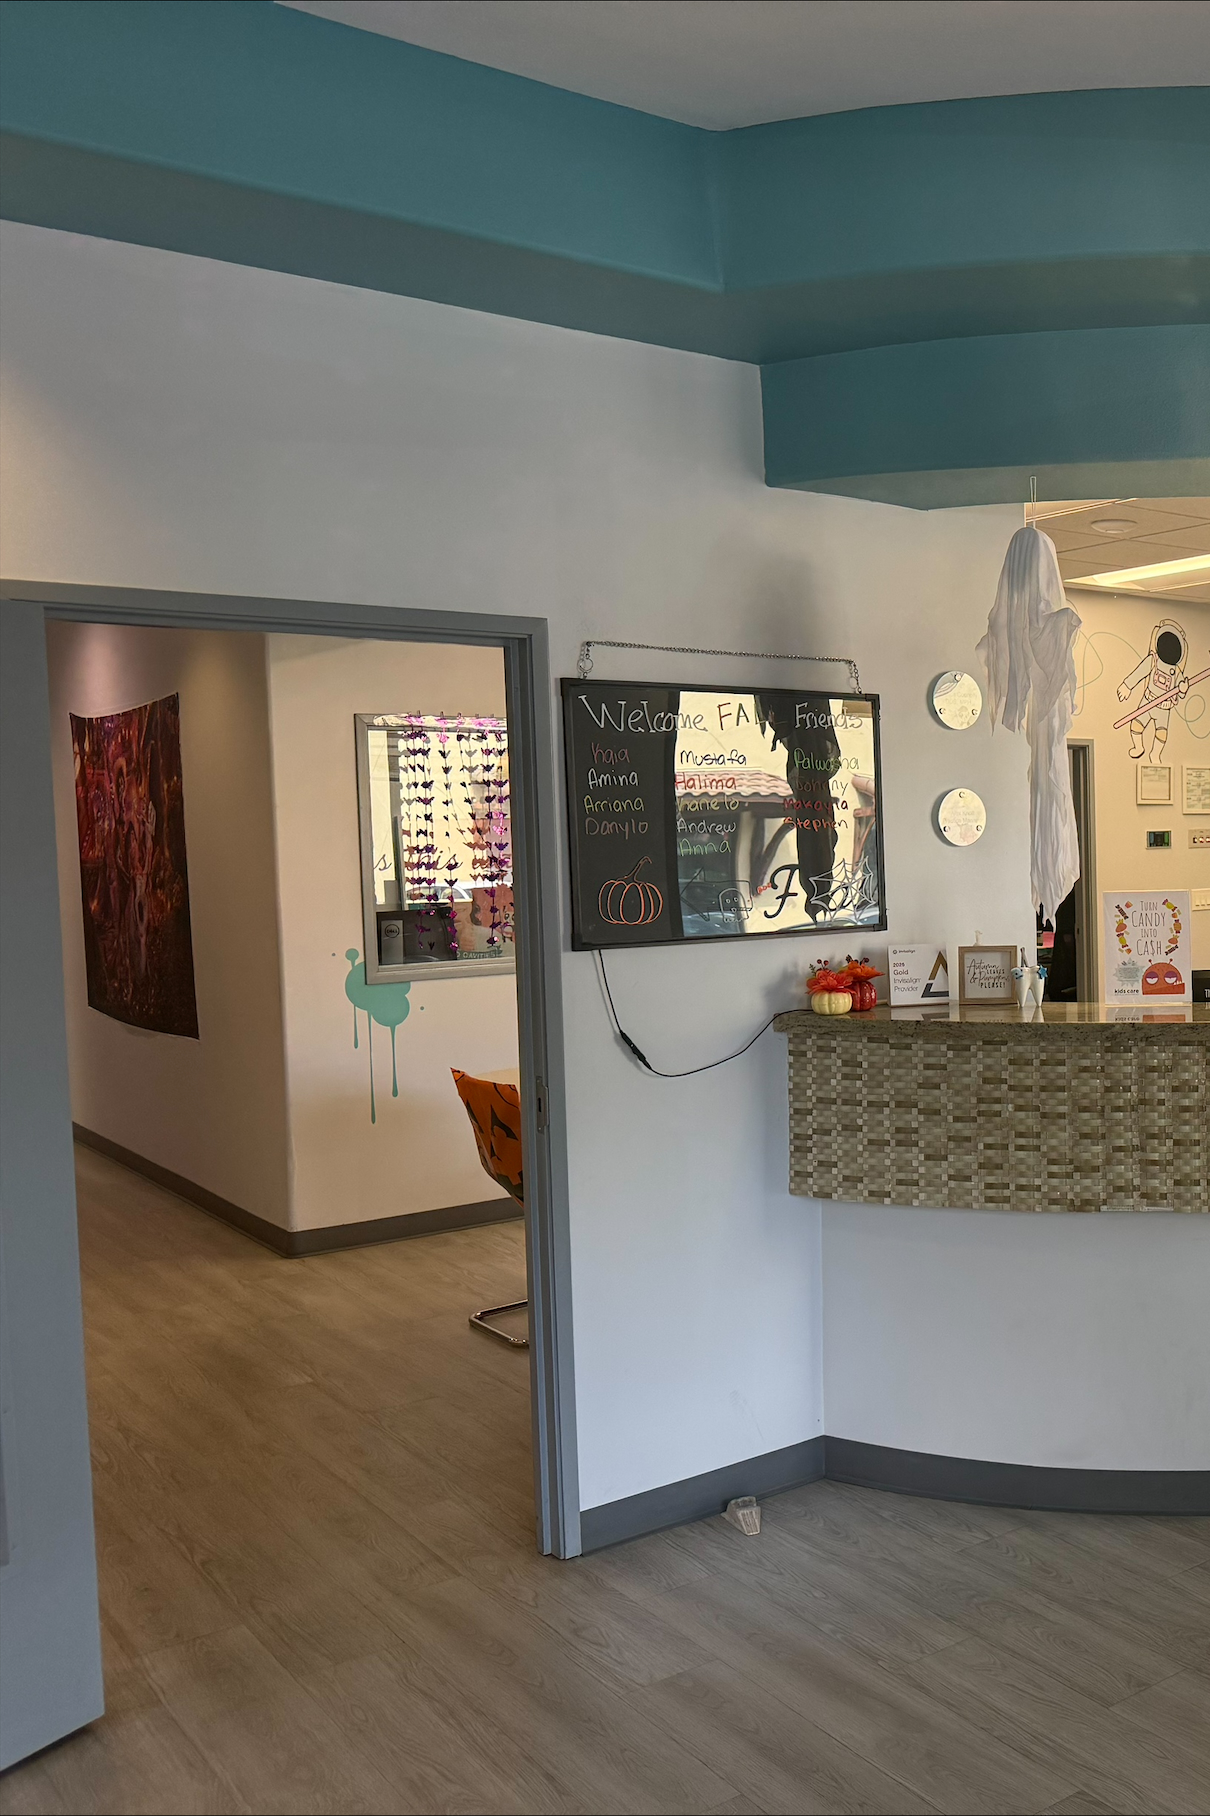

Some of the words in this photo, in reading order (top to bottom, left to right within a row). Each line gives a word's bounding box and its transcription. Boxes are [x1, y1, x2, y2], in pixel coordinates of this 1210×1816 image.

[578, 695, 708, 733] Welcome
[795, 702, 863, 729] Friends
[680, 749, 746, 766] Mustafa
[588, 768, 638, 790] Amina
[675, 772, 736, 790] Halima
[584, 795, 644, 814] Arriana
[586, 817, 648, 840] Danylo
[677, 818, 736, 835] Andrew
[784, 816, 848, 832] Stephen
[680, 838, 731, 856] Anna
[1140, 901, 1157, 911] TURN
[1132, 911, 1166, 927] CANDY
[1141, 929, 1157, 938] INTO
[967, 959, 999, 974] Autumn
